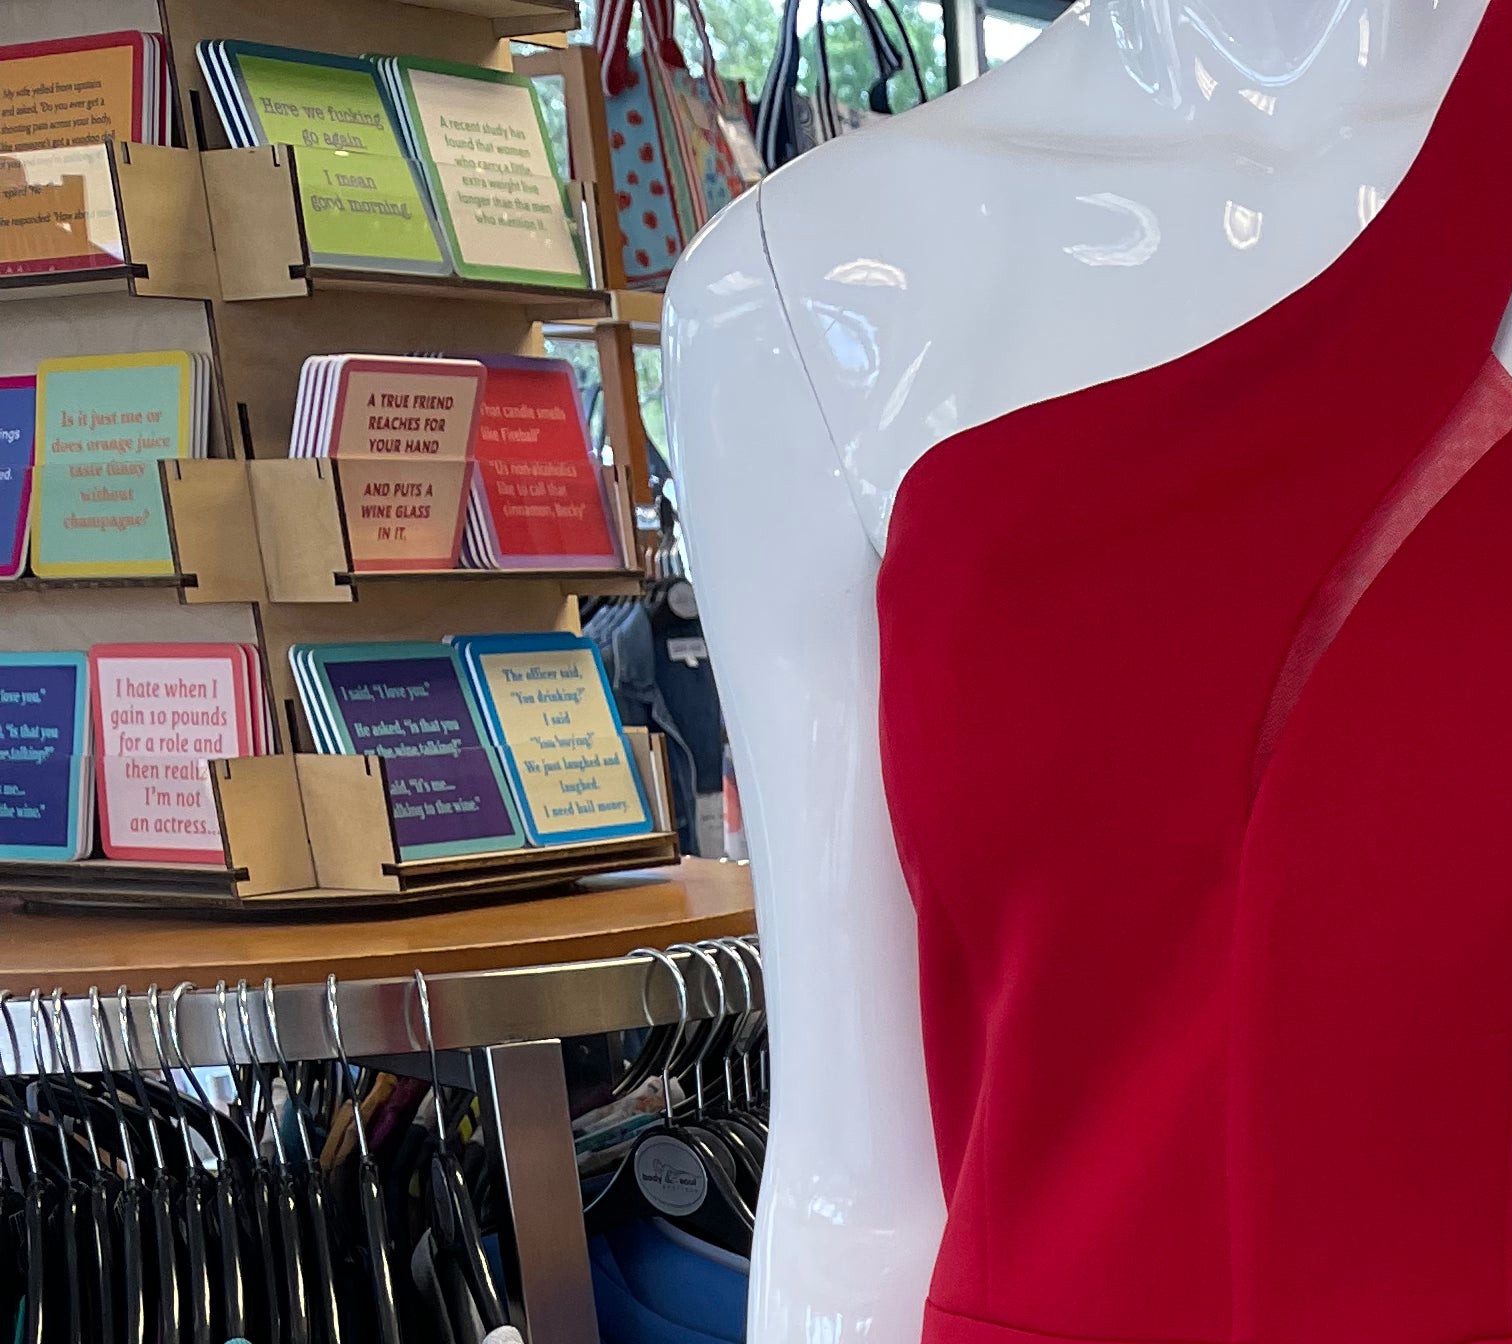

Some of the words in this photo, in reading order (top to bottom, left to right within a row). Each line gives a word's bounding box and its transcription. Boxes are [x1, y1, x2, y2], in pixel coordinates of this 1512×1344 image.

[259, 97, 300, 118] Here
[302, 105, 325, 120] we
[327, 105, 384, 131] fucking
[302, 128, 319, 147] go
[323, 169, 333, 186] I
[335, 172, 377, 190] mean
[310, 194, 345, 213] good
[367, 393, 376, 408] A
[380, 393, 411, 410] TRUE
[412, 394, 455, 411] FRIEND
[61, 410, 74, 428] Is
[78, 410, 89, 427] it
[90, 409, 118, 431] just
[121, 411, 143, 425] me
[146, 410, 162, 424] or
[368, 415, 421, 432] REACHES
[424, 417, 447, 432] FOR
[52, 439, 83, 454] does
[87, 438, 133, 456] orange
[136, 434, 171, 454] juice
[369, 438, 402, 453] YOUR
[404, 439, 440, 455] HAND
[69, 463, 104, 478] taste
[107, 460, 146, 478] funny
[80, 486, 135, 503] without
[363, 482, 391, 497] AND
[393, 482, 423, 498] PUTS
[425, 483, 434, 498] A
[361, 504, 392, 520] WINE
[395, 504, 431, 520] GLASS
[377, 526, 391, 542] IN
[394, 526, 408, 542] IT.
[502, 667, 524, 682] The
[526, 666, 557, 680] officer
[116, 678, 122, 699] I
[126, 678, 160, 698] hate
[164, 678, 207, 699] when
[212, 679, 218, 699] I
[110, 704, 145, 730] gain
[150, 710, 166, 725] 10
[171, 706, 228, 730] pounds
[551, 711, 571, 725] said
[354, 722, 371, 738] He
[118, 731, 141, 757] for
[145, 737, 155, 751] a
[159, 733, 189, 751] role
[193, 733, 223, 754] and
[125, 759, 159, 780] then
[524, 760, 541, 774] We
[542, 758, 562, 777] just
[562, 754, 601, 772] laughed
[603, 752, 621, 767] and
[144, 786, 171, 807] I'm
[176, 791, 201, 808] not
[390, 780, 412, 796] aid,
[552, 802, 575, 817] need
[130, 817, 149, 833] an
